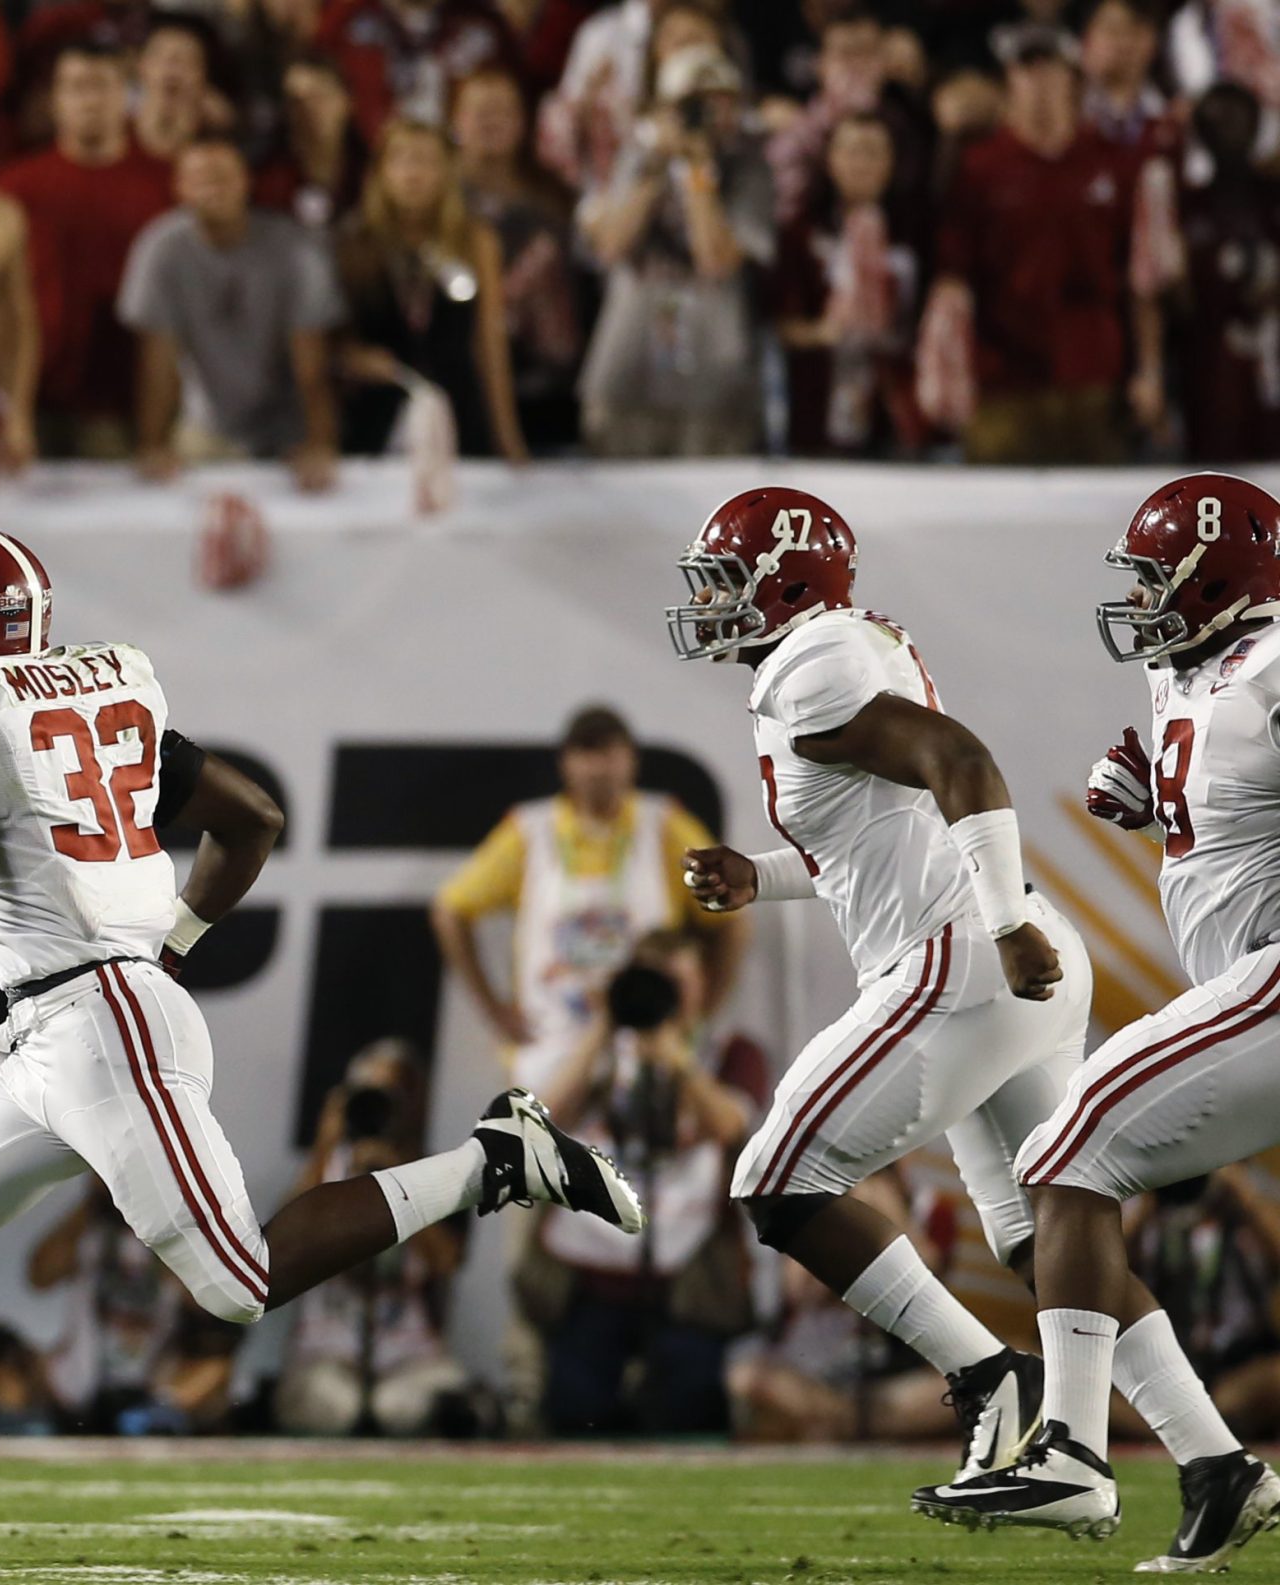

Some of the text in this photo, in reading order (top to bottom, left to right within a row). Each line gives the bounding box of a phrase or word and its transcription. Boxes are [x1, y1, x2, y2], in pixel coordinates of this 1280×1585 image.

[771, 508, 812, 551] 47
[1197, 496, 1221, 542] 8
[0, 649, 128, 701] MOSLEY
[30, 699, 164, 862] 32
[1155, 718, 1196, 858] 8
